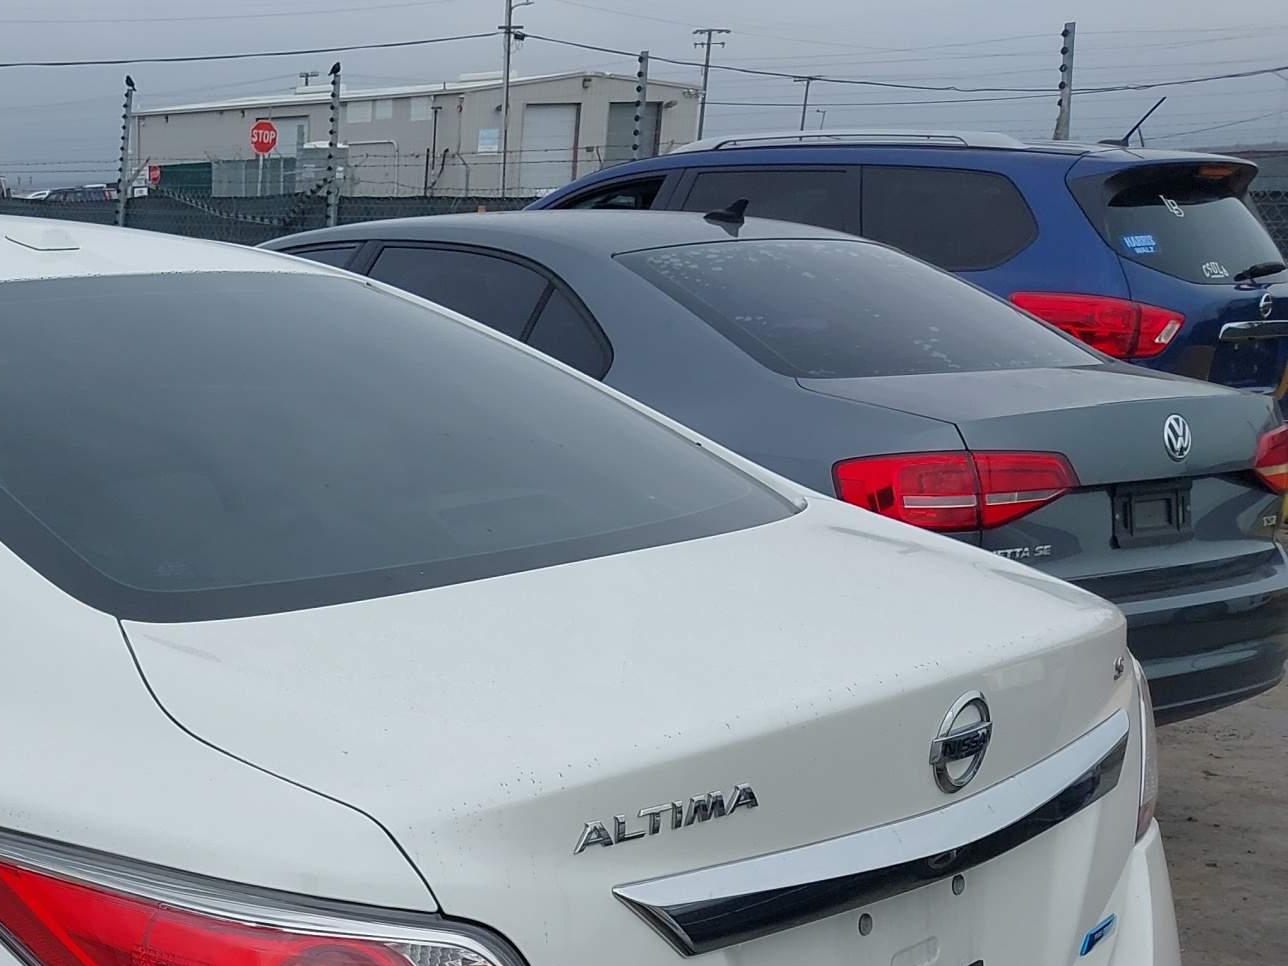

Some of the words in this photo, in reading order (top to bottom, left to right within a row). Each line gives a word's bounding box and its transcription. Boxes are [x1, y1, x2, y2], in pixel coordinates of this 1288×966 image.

[251, 129, 276, 143] STOP
[1034, 544, 1052, 557] SE
[573, 782, 759, 856] ALTIMA
